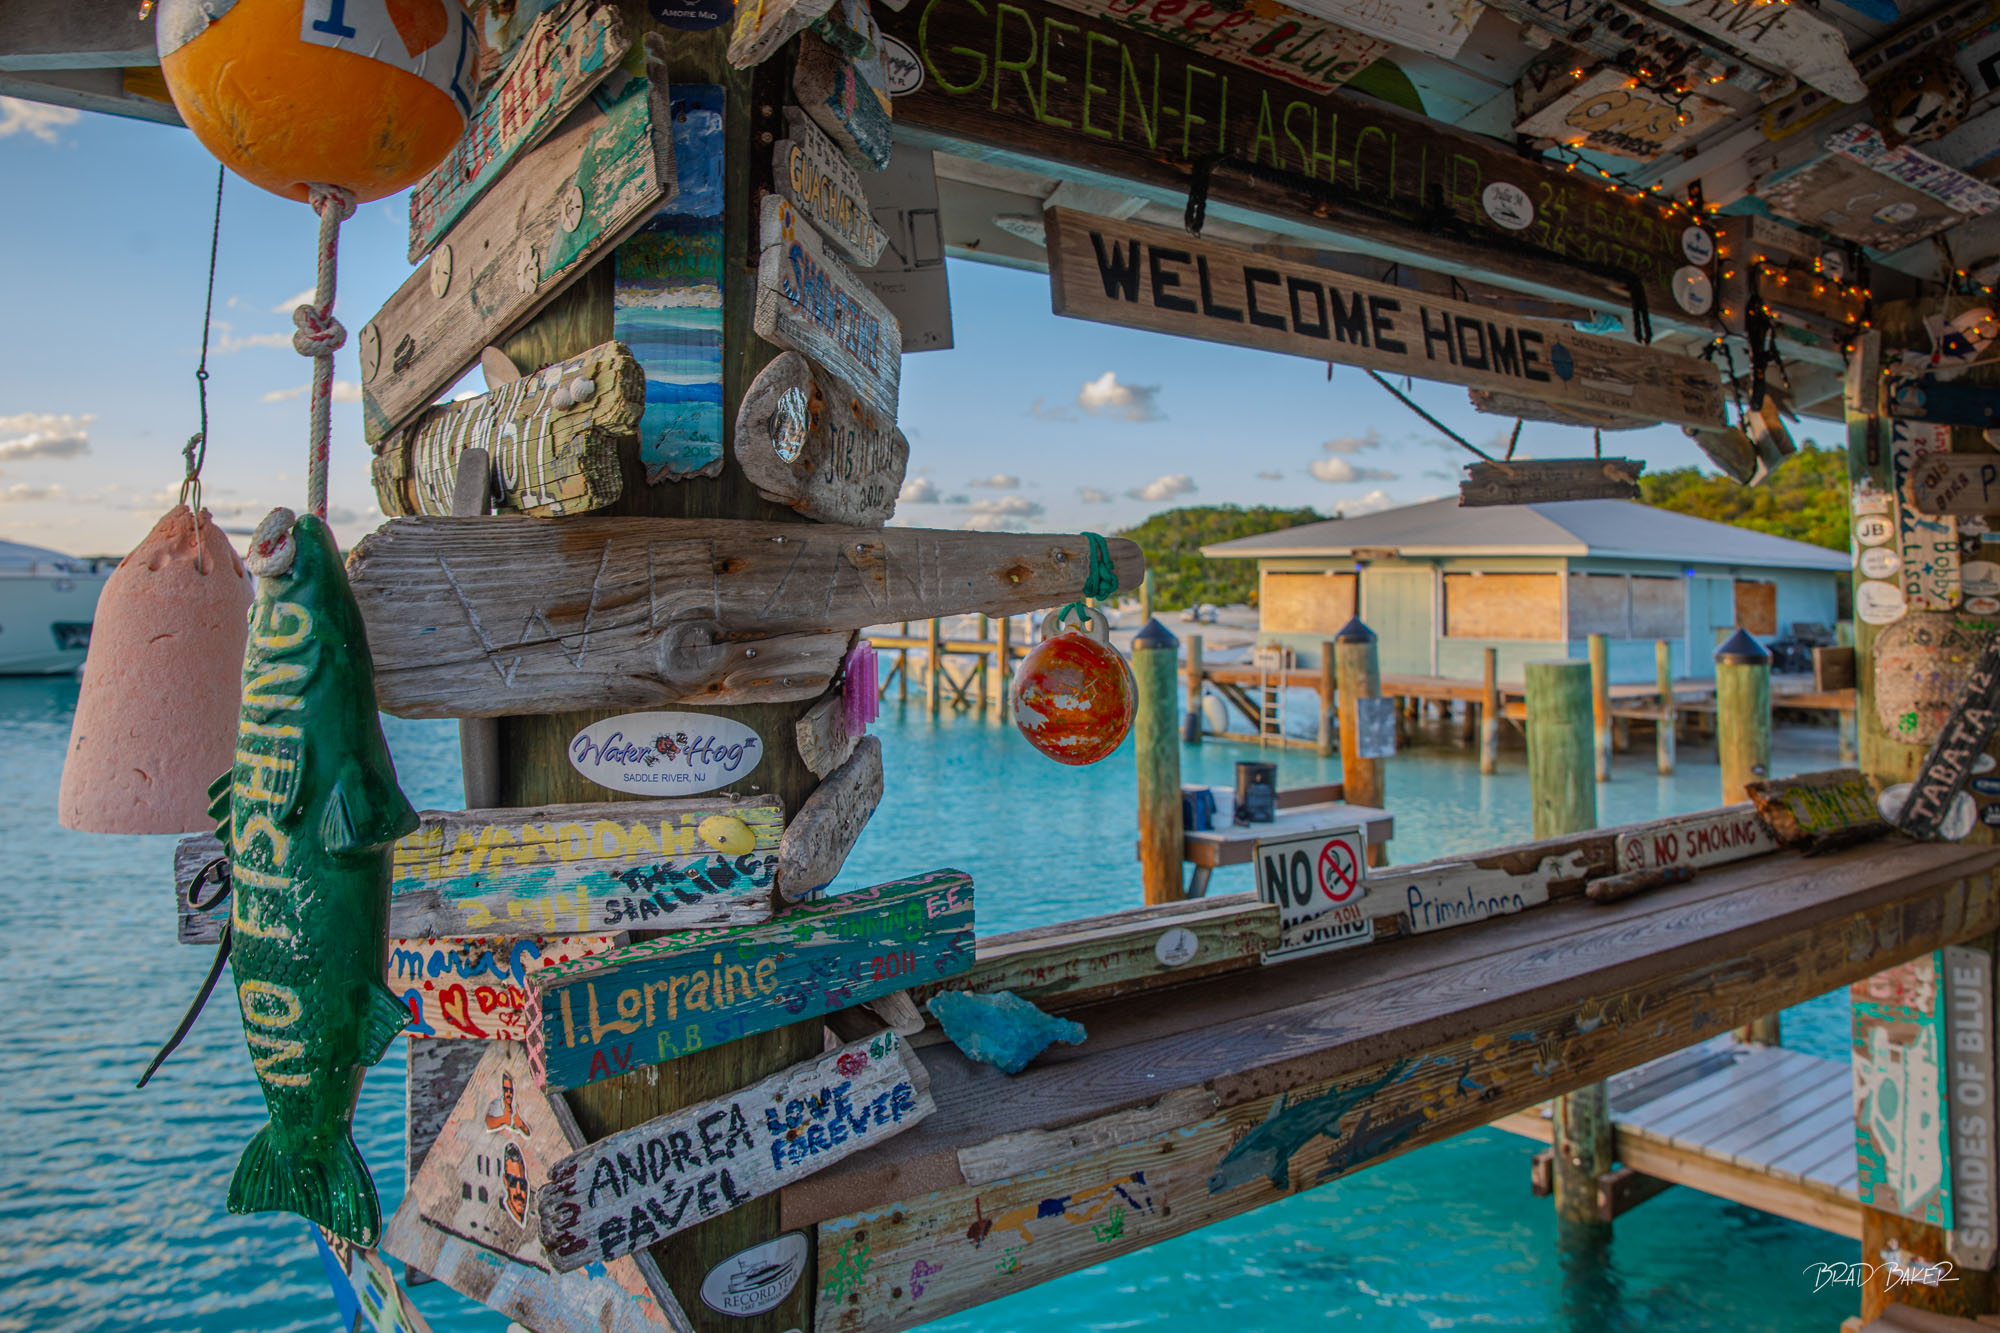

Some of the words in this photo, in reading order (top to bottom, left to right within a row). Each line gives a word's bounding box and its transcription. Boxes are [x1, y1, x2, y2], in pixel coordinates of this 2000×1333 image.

[1089, 231, 1407, 354] WELCOME
[1420, 305, 1551, 382] HOME
[231, 601, 315, 940] FISHING
[573, 733, 651, 765] Water
[684, 735, 743, 771] Hog
[623, 772, 659, 783] SADDLE
[661, 772, 691, 784] RIVER,
[693, 773, 706, 783] NJ
[1653, 833, 1679, 866] NO
[1686, 820, 1756, 858] SMOKING
[1265, 850, 1313, 909] NO
[870, 950, 915, 982] 2011
[240, 978, 312, 1087] NO
[1952, 966, 1984, 1053] BLUE
[1957, 1060, 1985, 1106] OF
[588, 1103, 754, 1208] ANDREA
[1957, 1122, 1989, 1250] SHADES
[724, 1285, 776, 1308] RECORD
